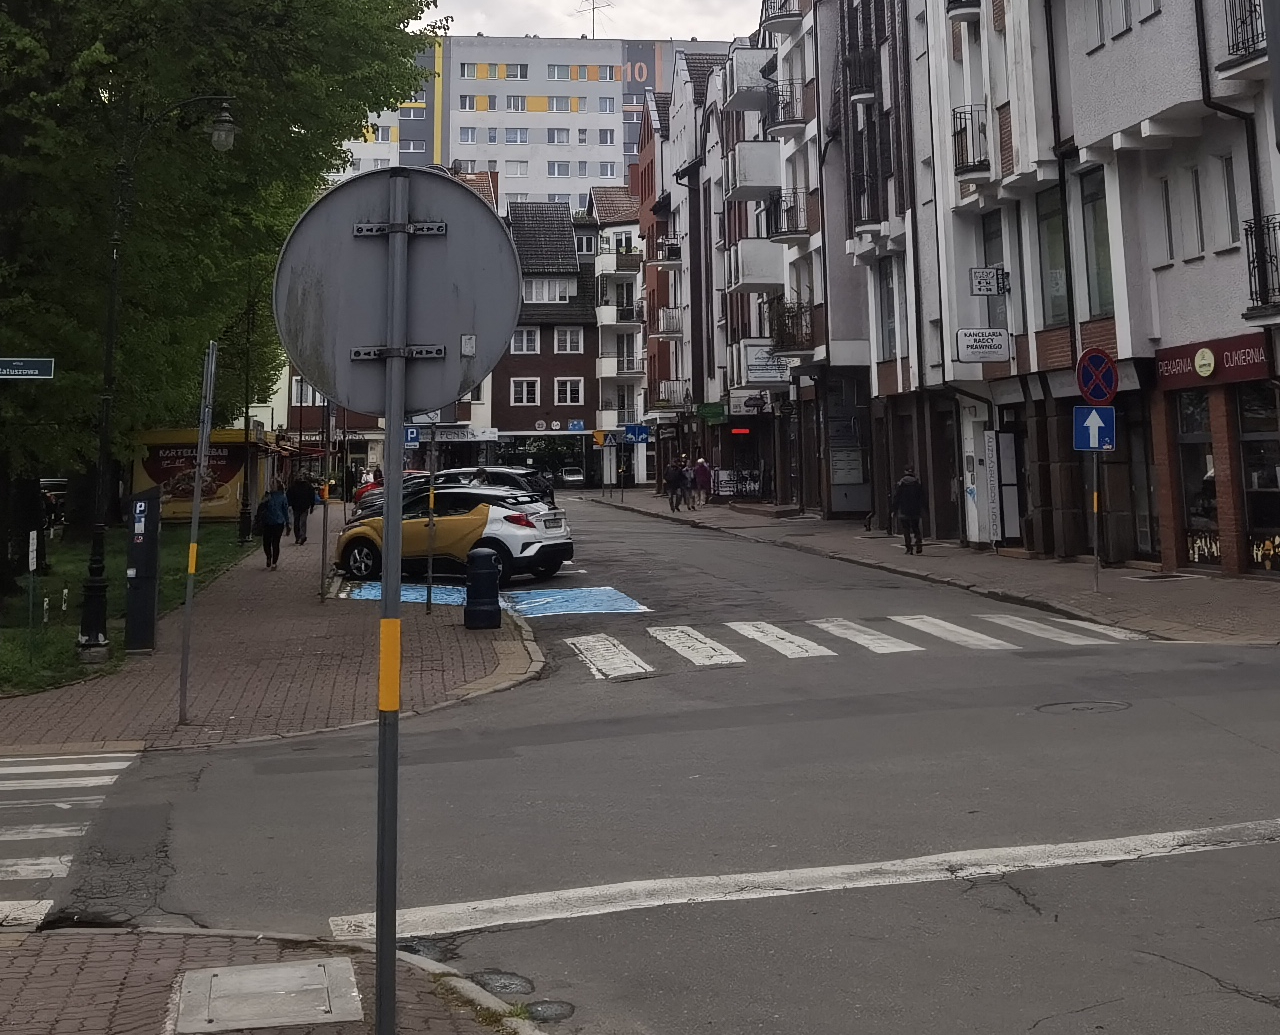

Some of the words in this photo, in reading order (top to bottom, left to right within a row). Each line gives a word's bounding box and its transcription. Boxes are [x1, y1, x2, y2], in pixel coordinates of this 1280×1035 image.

[622, 61, 648, 83] 10
[1158, 357, 1193, 376] PIEKARNIA
[1223, 346, 1267, 368] CUKIERNIA
[407, 428, 417, 441] P
[986, 434, 997, 504] kosmetyczny
[136, 502, 145, 514] P
[990, 506, 999, 538] salon
